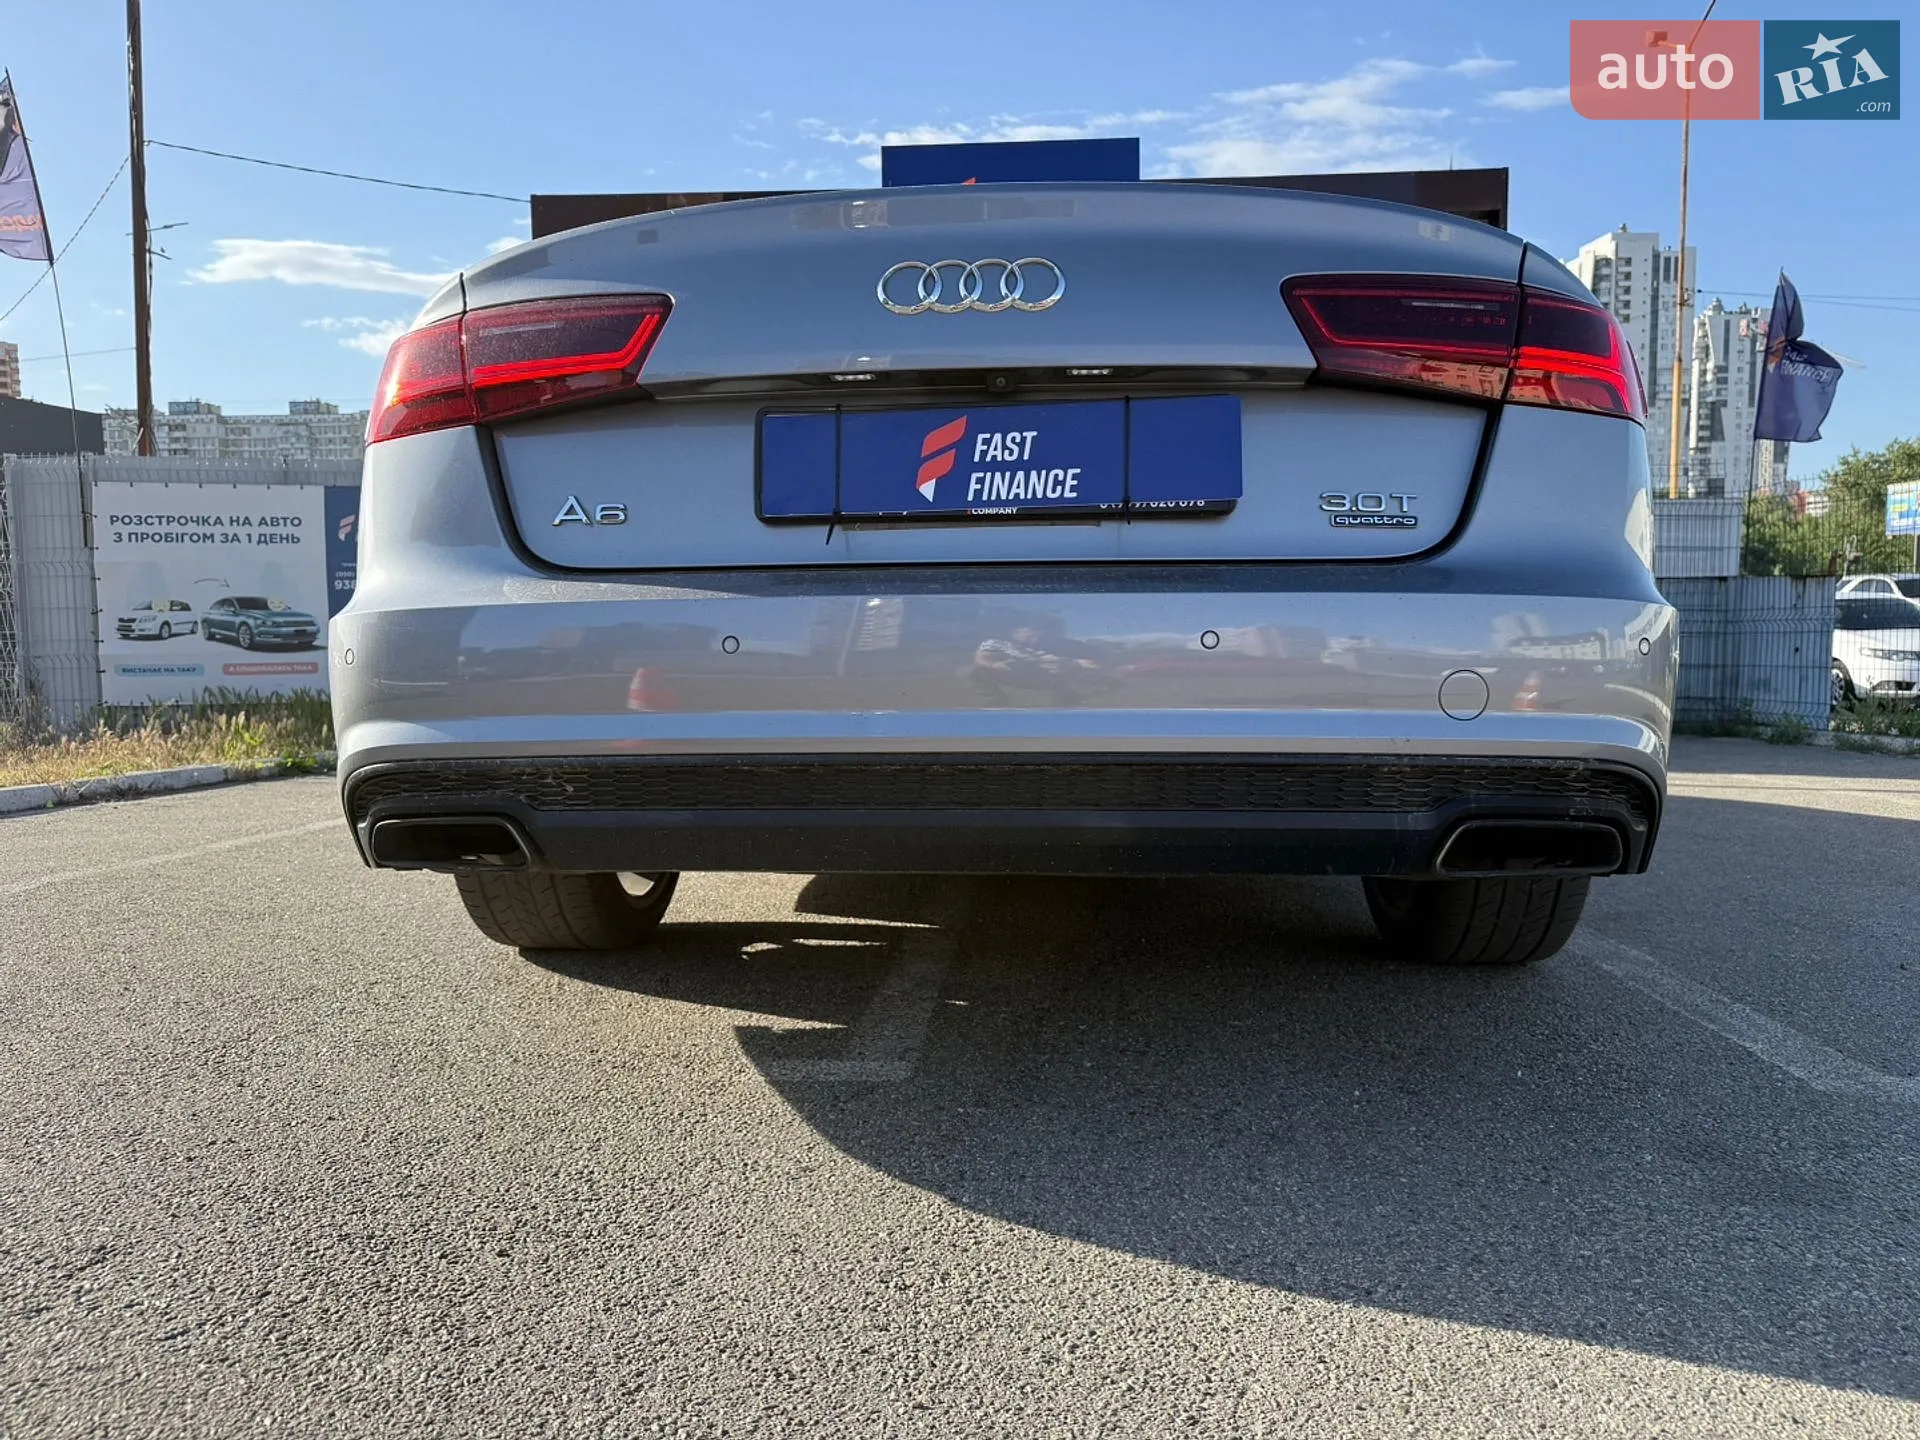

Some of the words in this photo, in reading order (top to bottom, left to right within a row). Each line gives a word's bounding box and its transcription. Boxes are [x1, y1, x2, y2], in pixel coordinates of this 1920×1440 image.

[973, 431, 1038, 463] FAST
[967, 468, 1081, 502] FINANCE
[552, 495, 627, 526] A6
[971, 506, 1018, 515] COMPANY
[109, 514, 225, 527] РОЗСТРОЧКА
[229, 515, 253, 527] НА
[257, 516, 302, 528] АВТО
[1335, 515, 1416, 525] quattro
[127, 531, 215, 544] ПРОБІГОМ
[219, 532, 242, 544] ЗА
[245, 533, 252, 544] 1
[256, 533, 301, 545] ДЕНЬ
